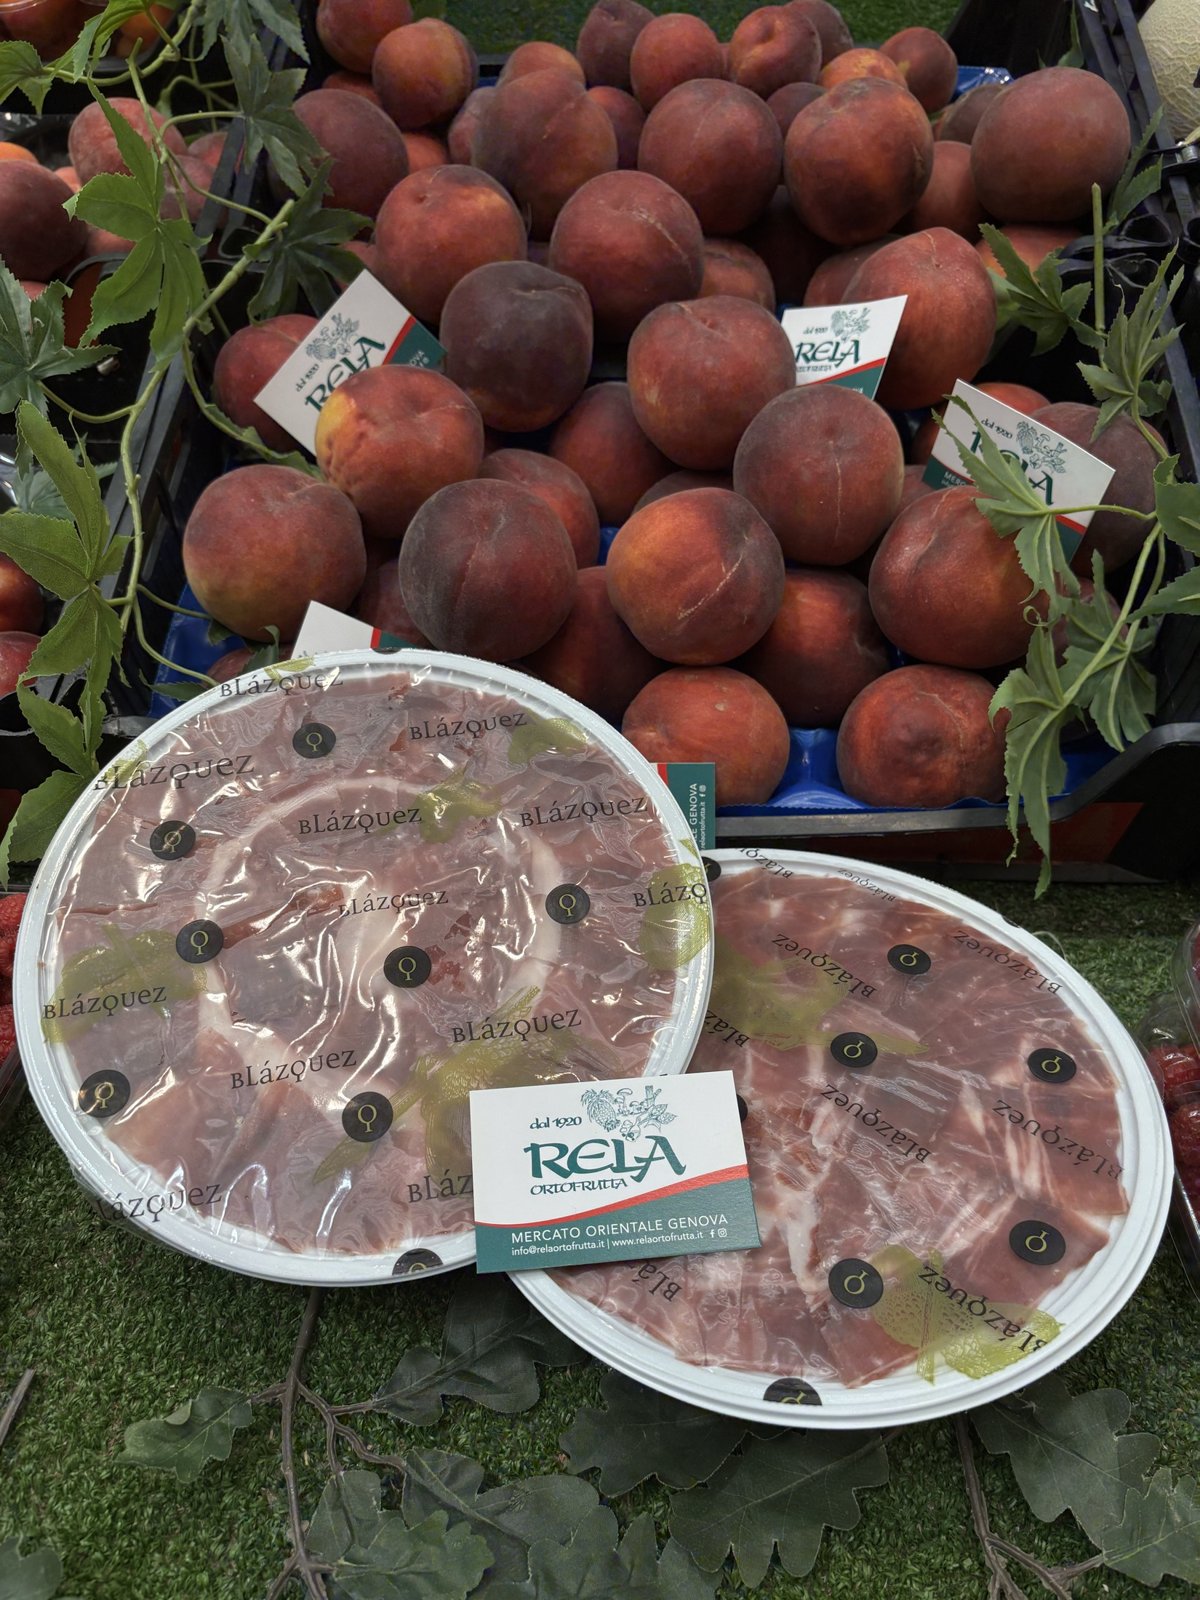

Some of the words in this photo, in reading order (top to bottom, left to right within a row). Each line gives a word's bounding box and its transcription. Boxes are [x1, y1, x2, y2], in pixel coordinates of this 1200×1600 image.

[795, 339, 861, 369] RELA
[689, 783, 698, 825] GENOVA
[633, 881, 707, 908] BLázQ
[529, 1117, 550, 1130] dal
[552, 1116, 582, 1129] 1920
[523, 1135, 687, 1182] RELA
[407, 1168, 474, 1204] BLáz
[530, 1178, 628, 1196] ORTOFRUTTA
[511, 1227, 581, 1244] MERCATO
[586, 1219, 663, 1237] ORIENTALE
[668, 1213, 728, 1230] GENOVA
[511, 1239, 605, 1256] info@relaortofrutta.it
[611, 1230, 703, 1247] www.relaortofrutta.it
